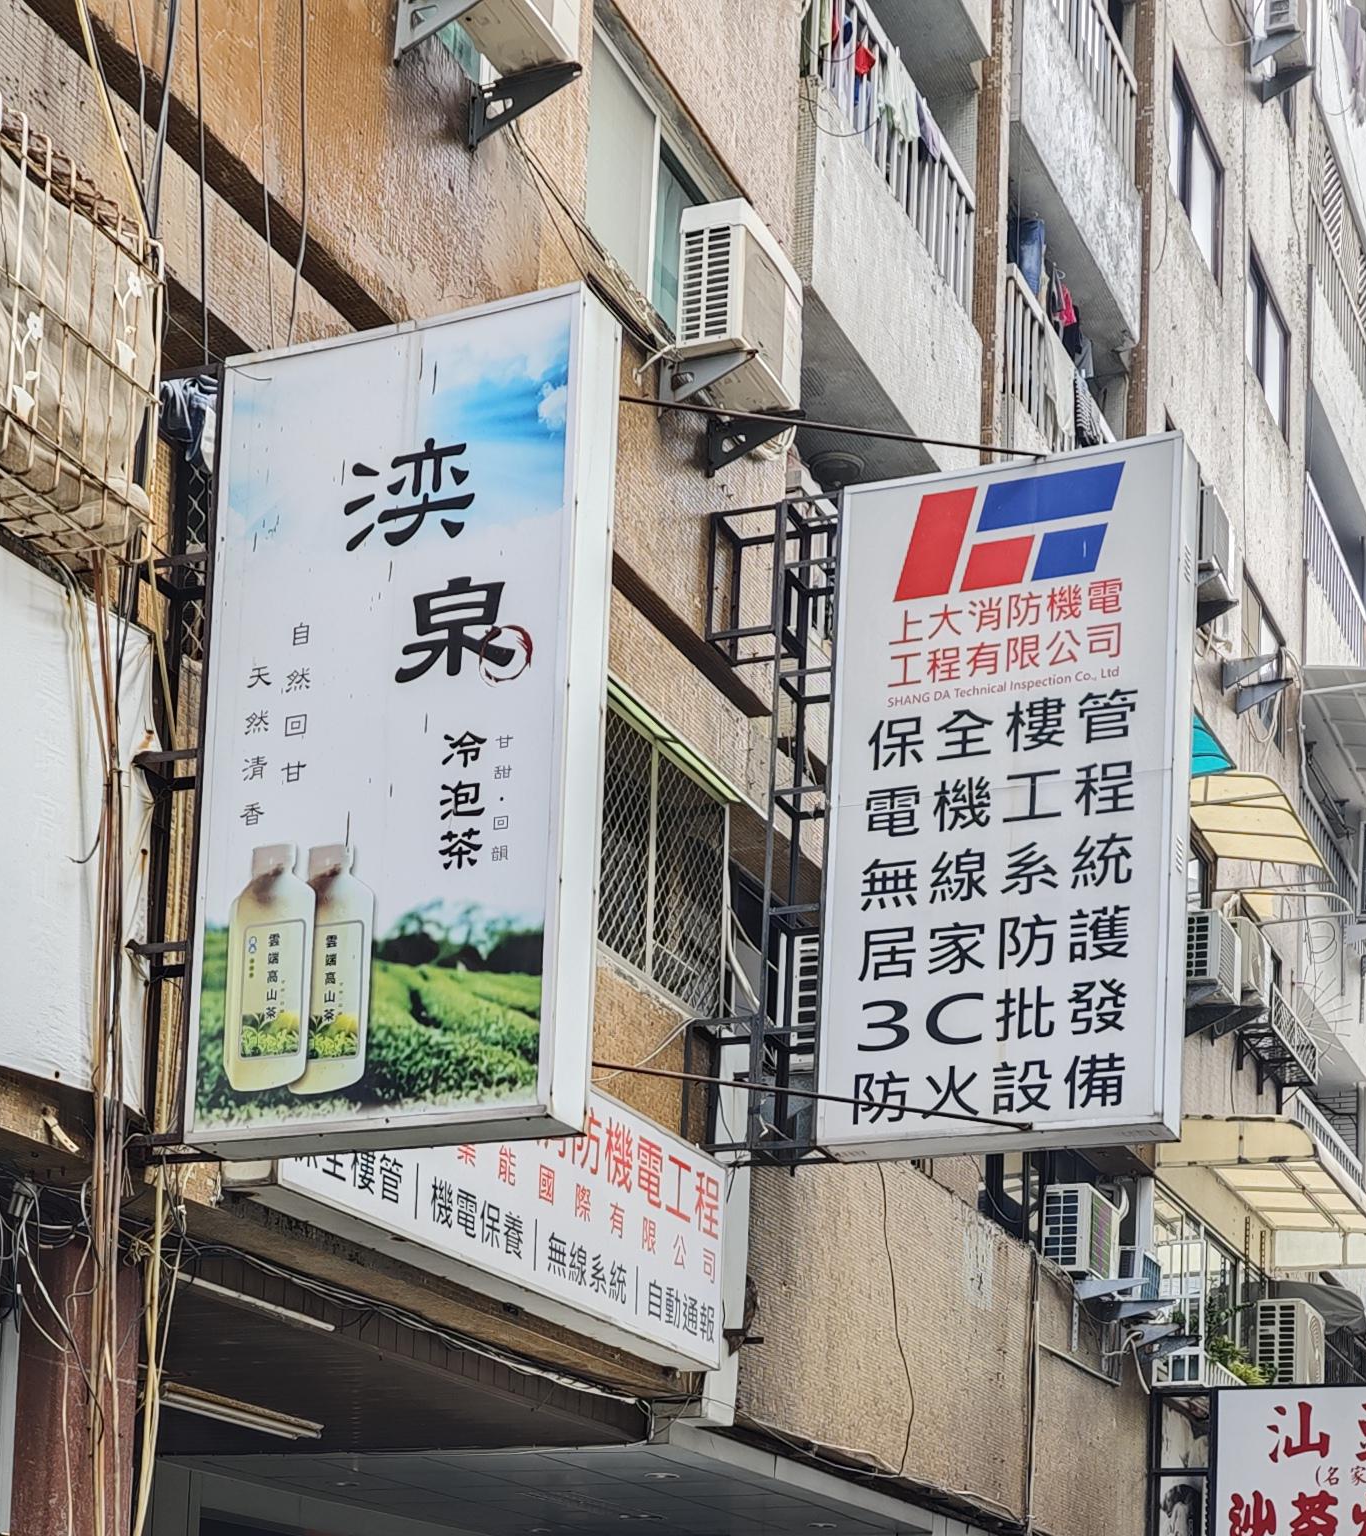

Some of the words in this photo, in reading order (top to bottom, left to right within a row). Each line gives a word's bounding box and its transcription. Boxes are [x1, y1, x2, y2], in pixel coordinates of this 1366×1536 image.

[888, 577, 1124, 646] 上大消防機電
[887, 621, 1123, 688] 工程有限公司
[887, 691, 931, 708] SHANG
[933, 689, 952, 702] DA
[954, 683, 1007, 699] Technical
[1009, 673, 1072, 694] Inspection
[1100, 665, 1121, 680] Ltd
[281, 622, 311, 783] 自然回甘
[867, 688, 1138, 771] 保全樓管
[239, 666, 272, 826] 天然清香
[438, 730, 487, 870] 冷泡茶
[864, 760, 1135, 838] 電機工程
[860, 831, 1134, 912] 無線系統
[857, 904, 1130, 982] 居家防護
[856, 977, 1128, 1053] 3C批發
[851, 1052, 1126, 1126] 防火設備
[430, 1174, 524, 1261] 機電保養
[547, 1230, 627, 1306] 無線系統
[646, 1279, 717, 1344] 自動通報
